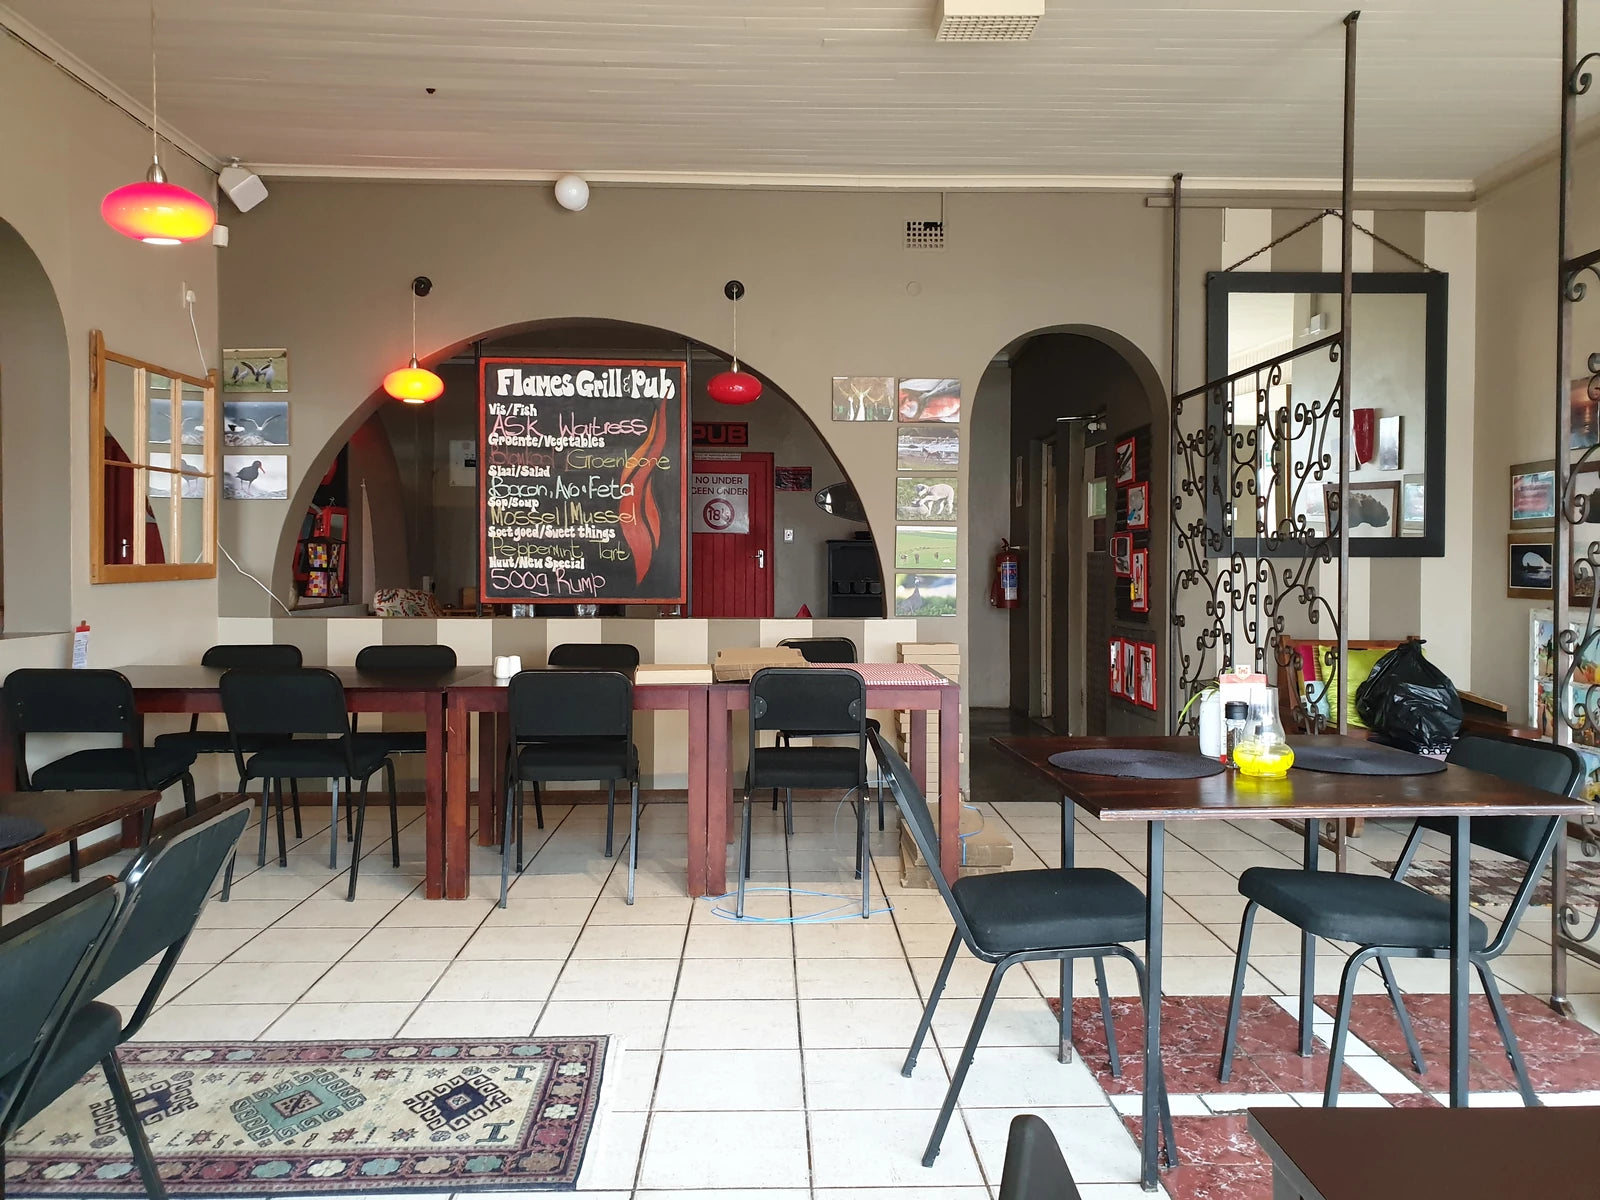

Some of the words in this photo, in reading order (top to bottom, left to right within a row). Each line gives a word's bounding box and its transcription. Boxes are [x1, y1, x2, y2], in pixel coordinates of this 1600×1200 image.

[497, 369, 575, 397] Flames
[576, 369, 623, 398] Grill
[631, 369, 675, 399] Pub
[488, 403, 538, 416] Vis/Fish
[559, 411, 648, 439] Waitress
[488, 433, 605, 451] Groente/Vegetables
[692, 425, 746, 443] PUB
[488, 465, 551, 477] Slaai/Salad
[695, 476, 710, 484] NO
[711, 476, 743, 485] UNDER
[691, 486, 714, 495] GEEN
[716, 487, 748, 496] ONDER
[487, 497, 540, 512] Sop/Soup
[577, 523, 616, 542] things
[488, 556, 543, 568] Nuut/New
[544, 556, 585, 572] Special
[491, 568, 550, 597] 500g
